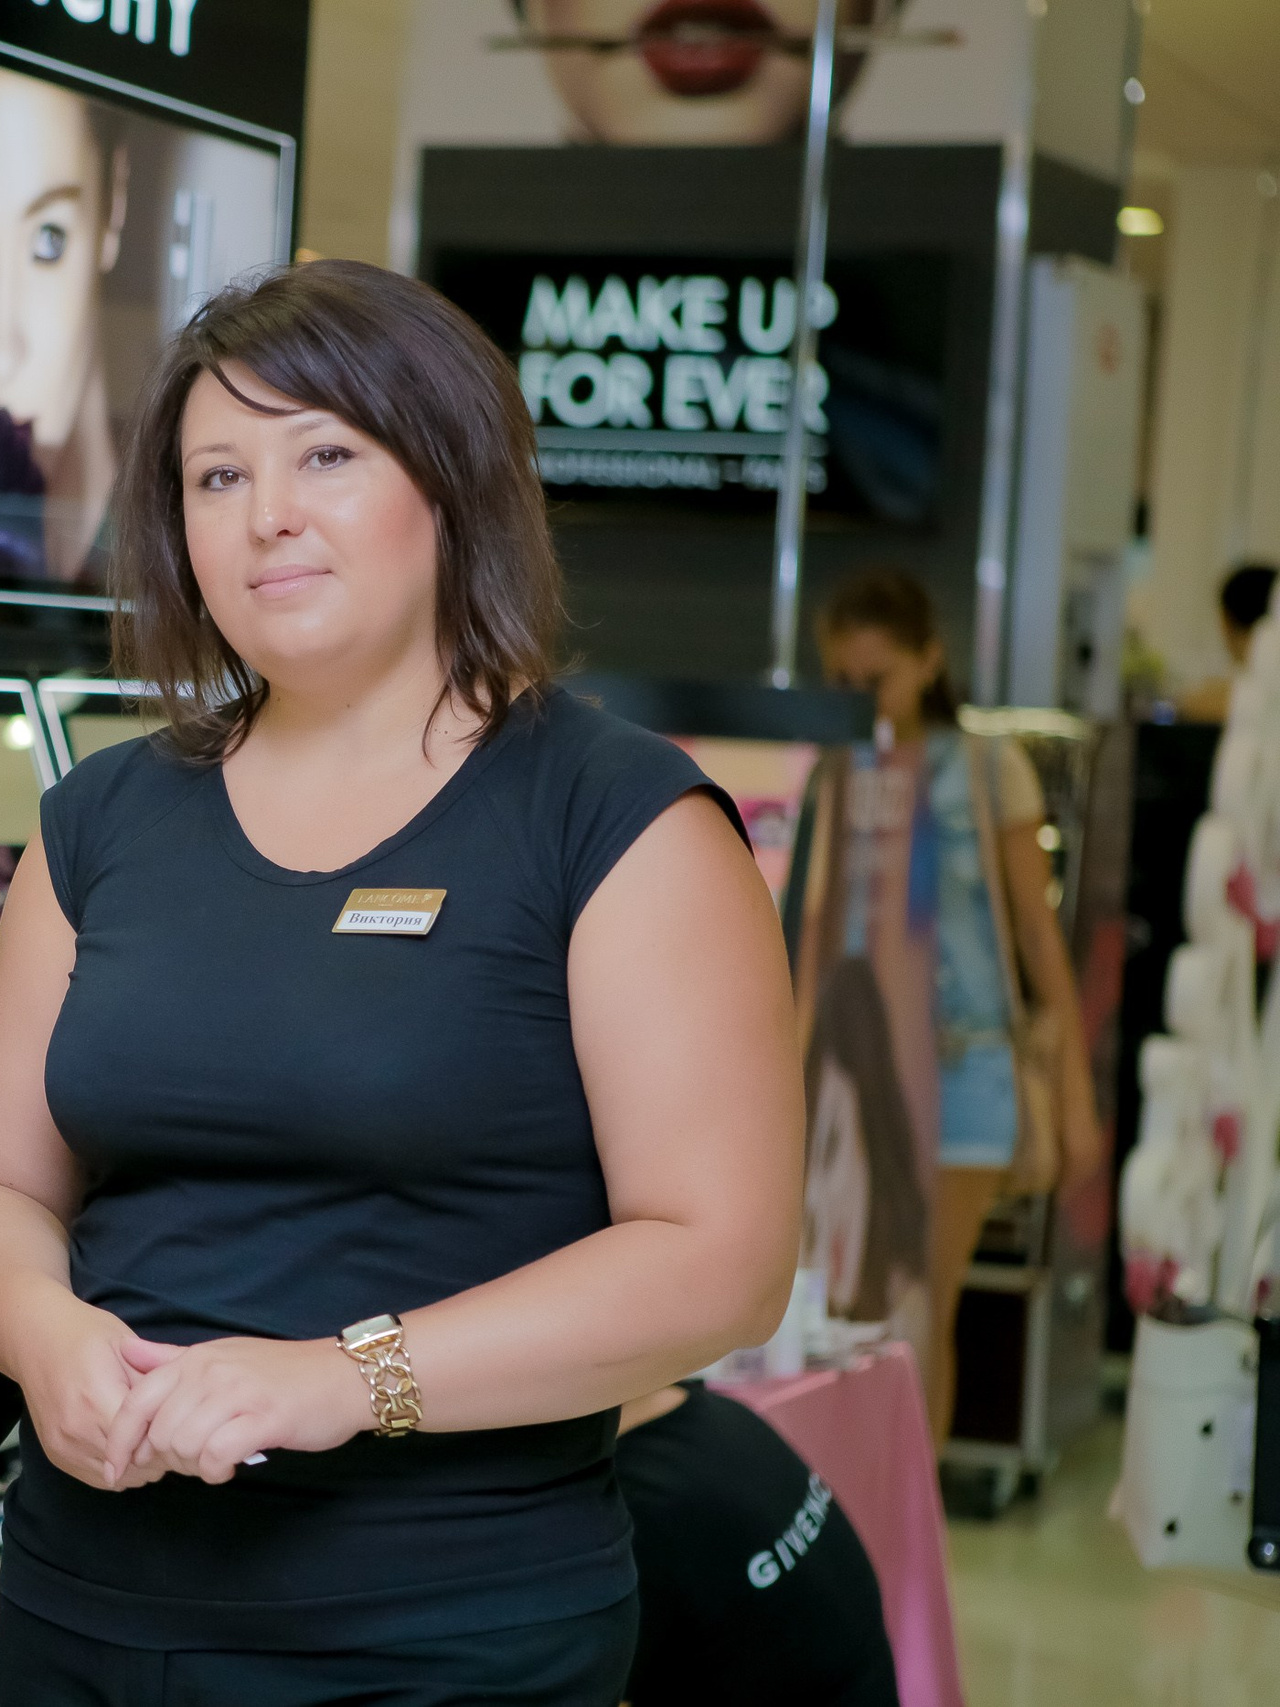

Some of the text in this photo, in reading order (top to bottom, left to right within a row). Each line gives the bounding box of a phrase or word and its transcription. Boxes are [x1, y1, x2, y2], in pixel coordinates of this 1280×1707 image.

[521, 273, 729, 350] MAKE
[519, 351, 831, 433] FOR EVER
[348, 912, 423, 928] Виктория
